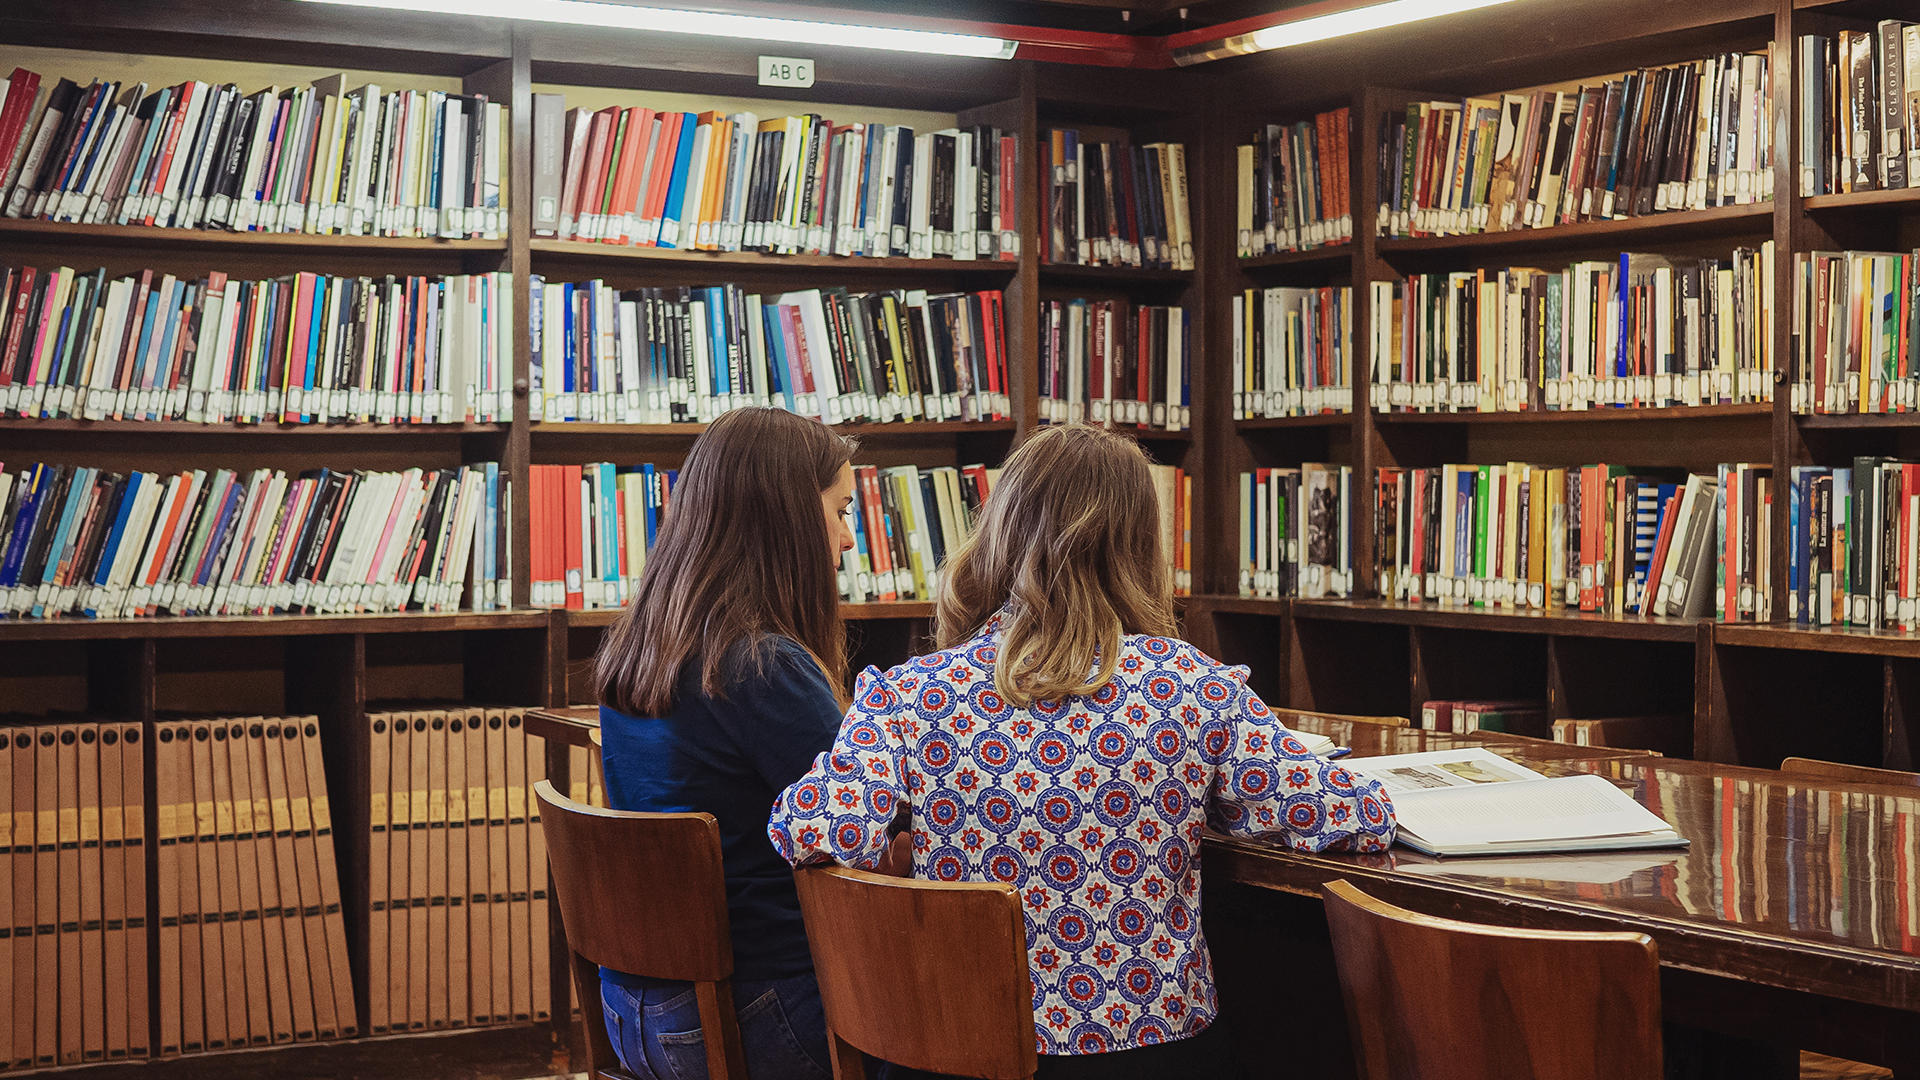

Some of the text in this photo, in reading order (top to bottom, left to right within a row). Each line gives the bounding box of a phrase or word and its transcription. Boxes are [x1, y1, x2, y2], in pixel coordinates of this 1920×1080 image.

[166, 100, 187, 155] Language in Art
[1405, 127, 1413, 157] GOYA
[1404, 161, 1410, 174] DE
[1454, 164, 1464, 188] Art
[682, 313, 690, 330] THE
